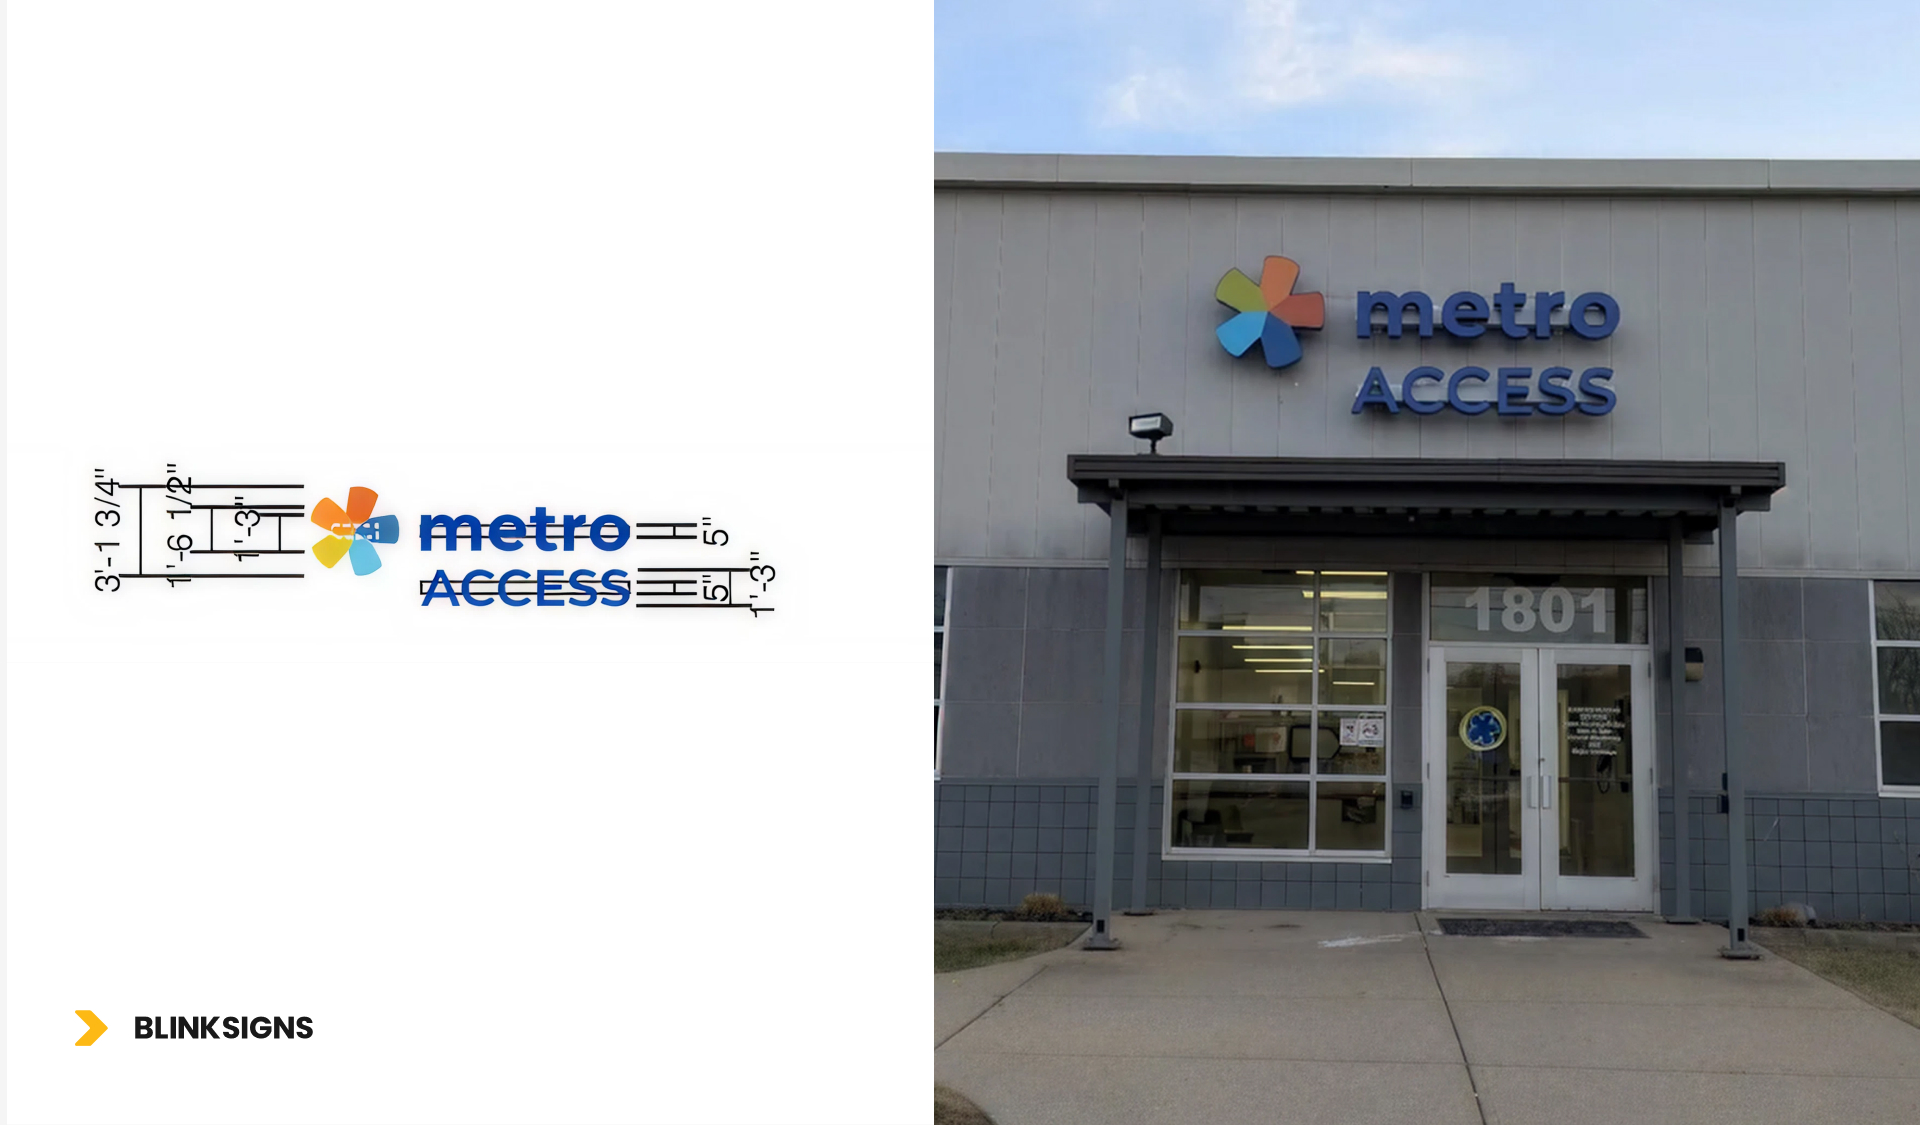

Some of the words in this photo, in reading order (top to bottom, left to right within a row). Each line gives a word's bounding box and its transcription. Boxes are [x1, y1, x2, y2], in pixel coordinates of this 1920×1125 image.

[1356, 282, 1621, 340] metro
[1351, 366, 1618, 416] ACCESS
[1465, 586, 1606, 633] 1801
